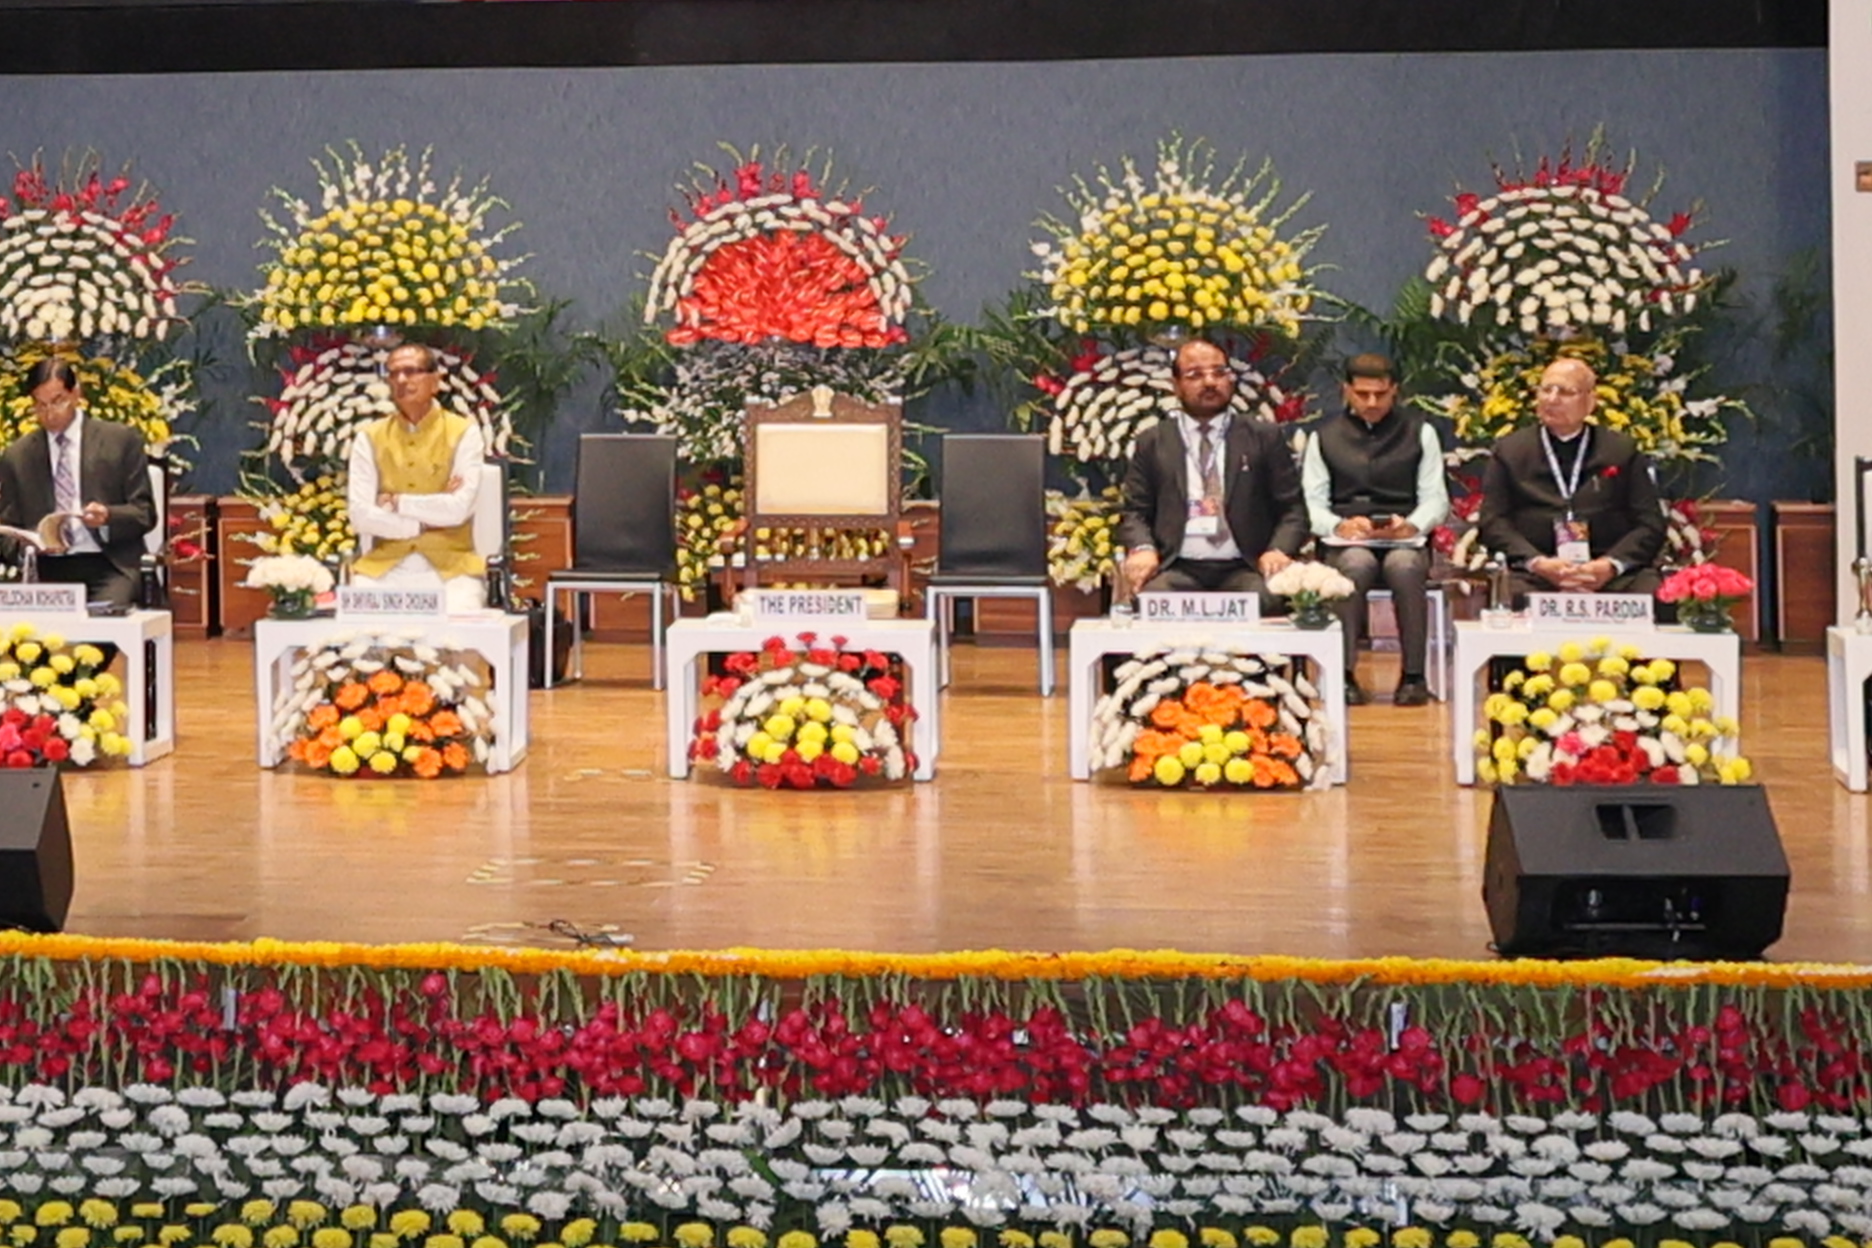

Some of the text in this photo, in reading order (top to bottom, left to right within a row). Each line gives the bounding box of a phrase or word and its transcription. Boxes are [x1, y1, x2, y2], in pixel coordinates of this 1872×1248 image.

[759, 595, 862, 614] THE PRESIDENT
[1147, 598, 1177, 617] DR.
[1595, 599, 1649, 618] PARODA
